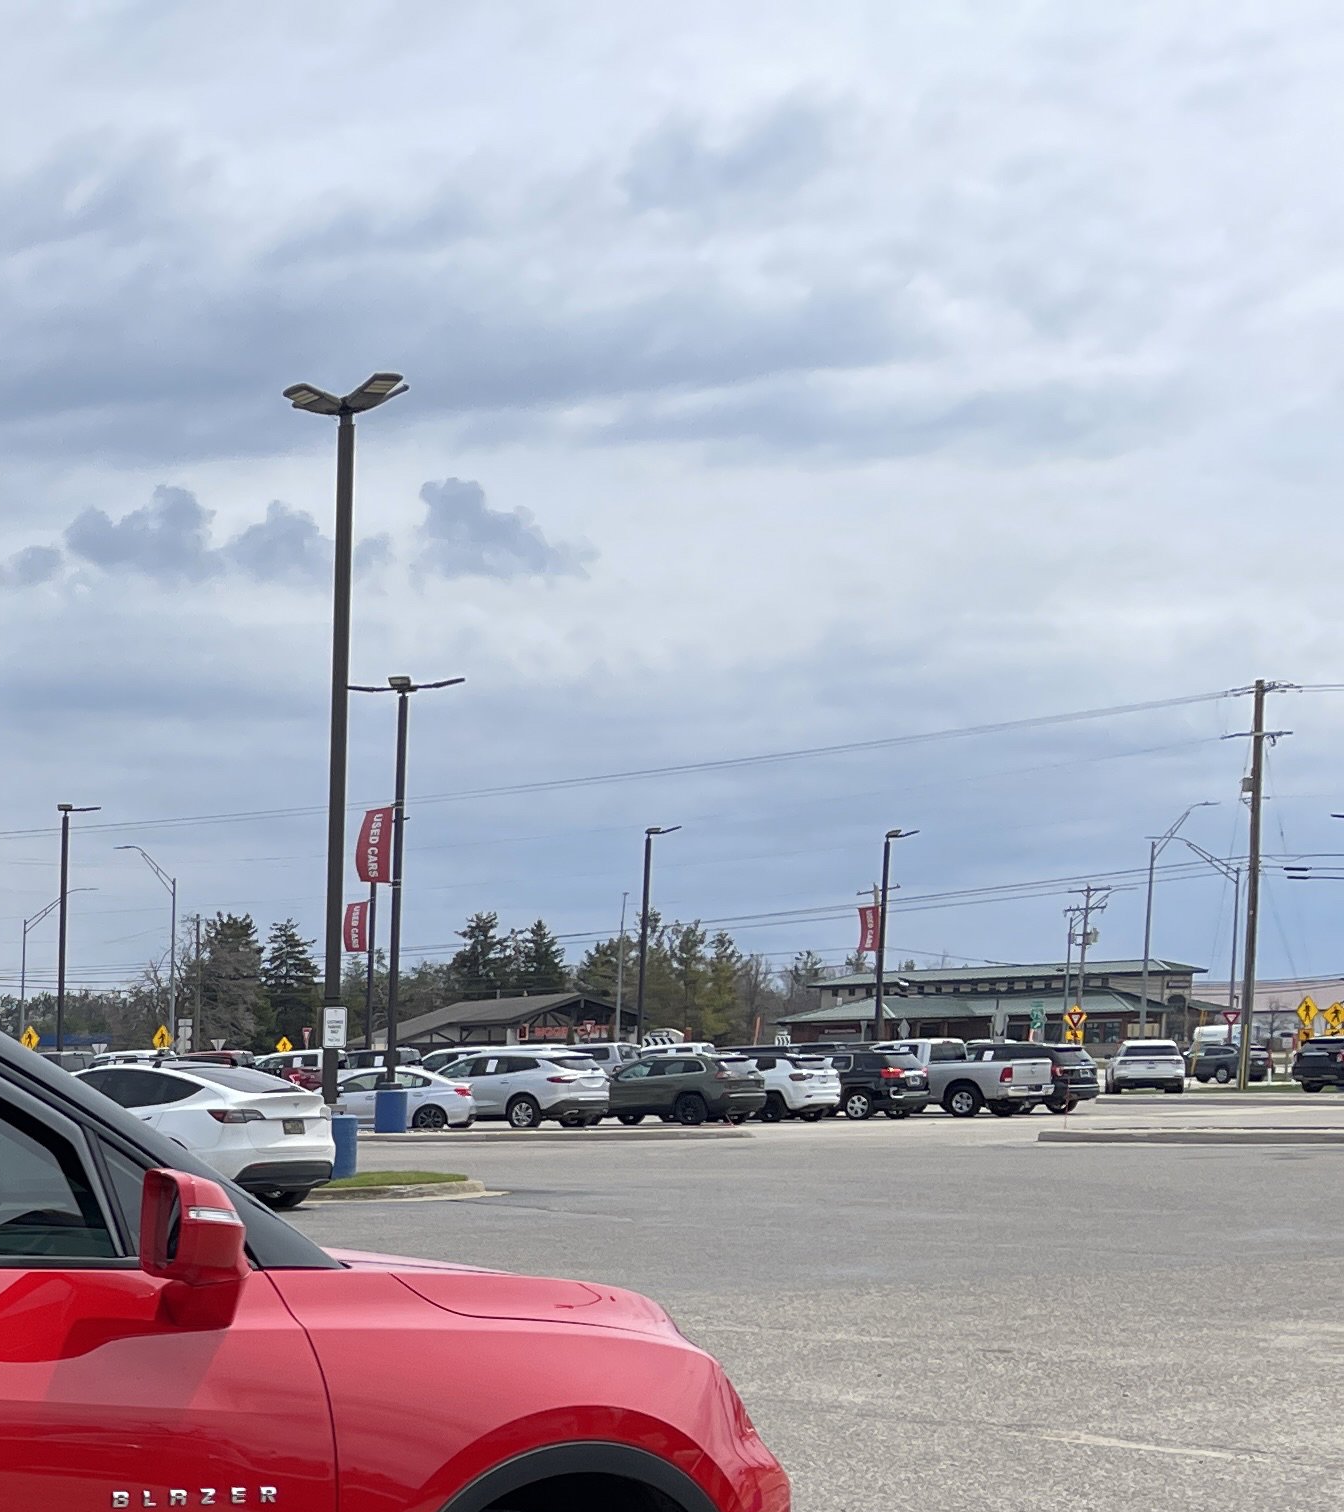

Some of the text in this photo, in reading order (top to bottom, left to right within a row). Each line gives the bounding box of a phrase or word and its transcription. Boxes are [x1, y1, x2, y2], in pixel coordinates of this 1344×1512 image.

[367, 813, 383, 877] USED CARS
[112, 1486, 278, 1508] BLAZER
